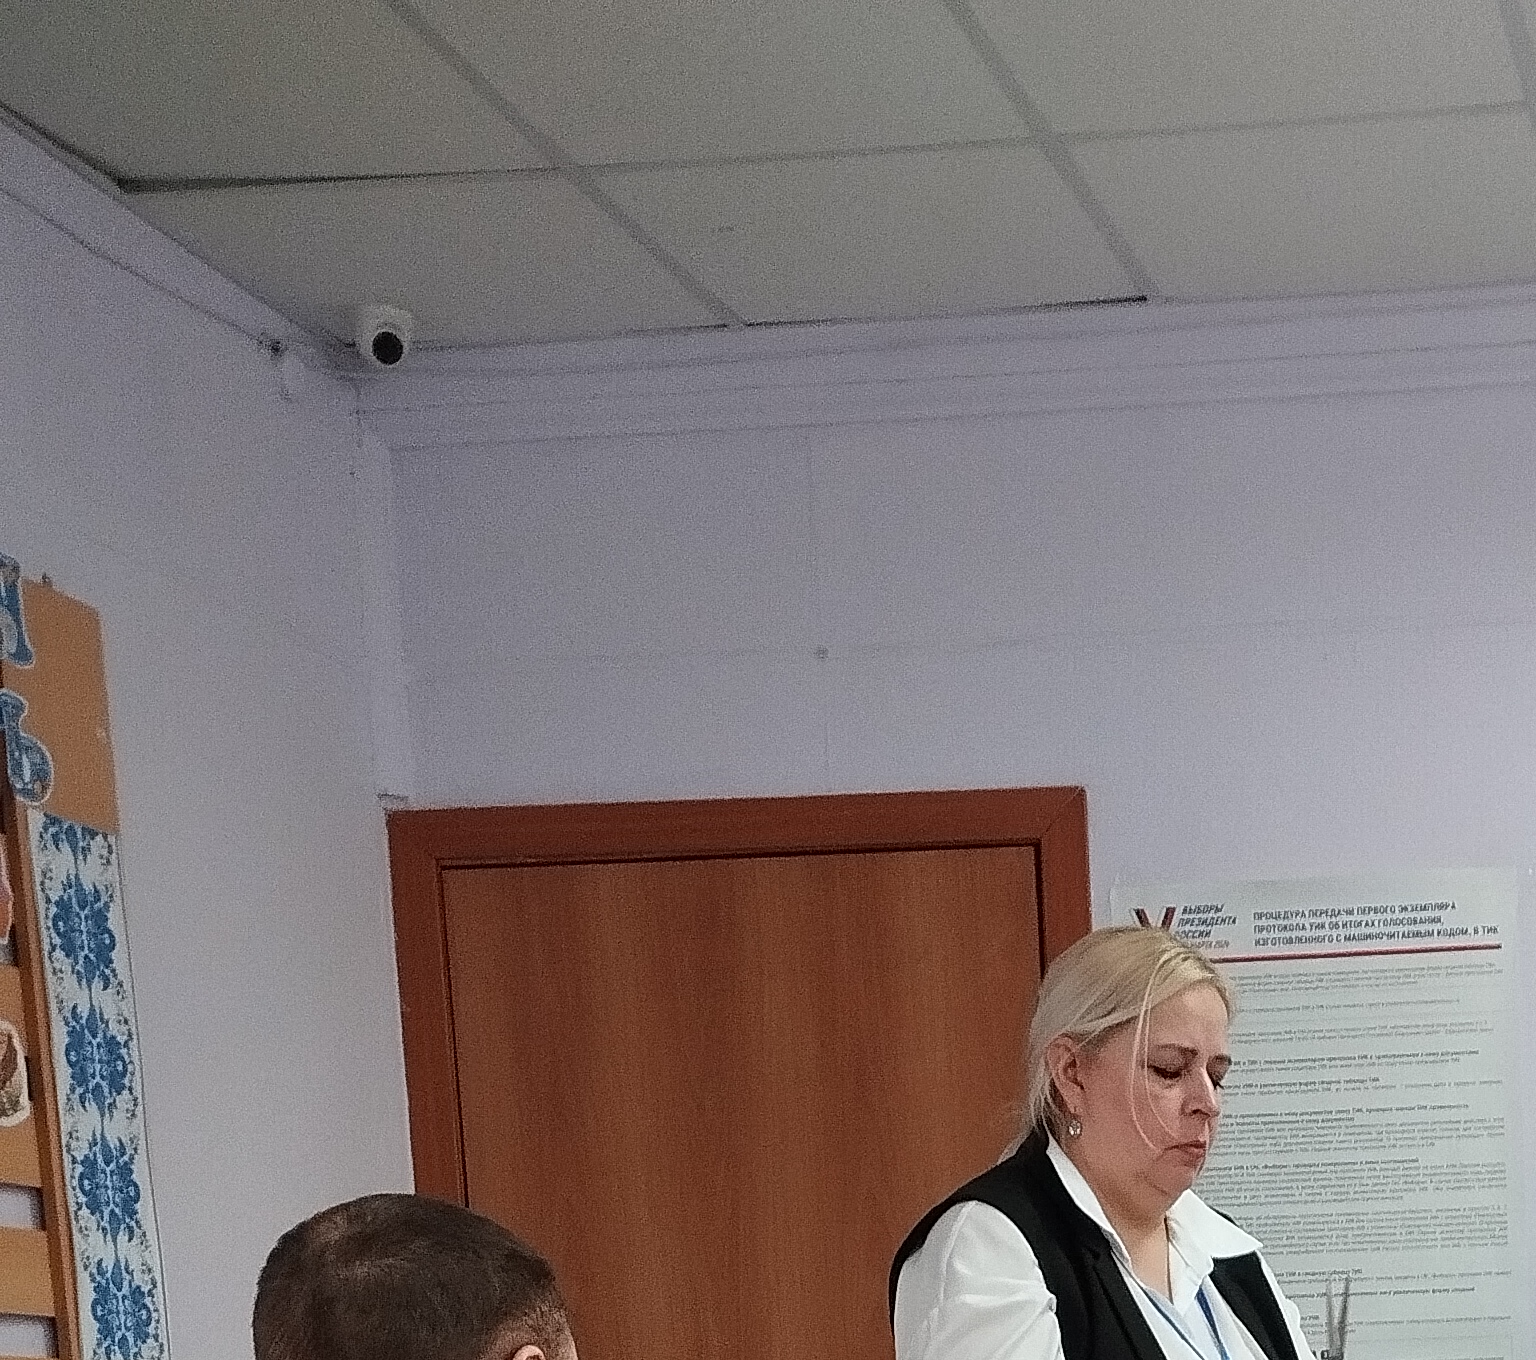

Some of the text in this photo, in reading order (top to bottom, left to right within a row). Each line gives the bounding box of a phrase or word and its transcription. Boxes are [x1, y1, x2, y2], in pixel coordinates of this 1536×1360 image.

[1181, 904, 1224, 916] ВЫБОРЫ
[1253, 909, 1306, 921] ПРОЦЕДУРА
[1308, 907, 1355, 919] ПЕРЕДАЧИ
[1357, 904, 1396, 916] ПЕРВОГО
[1177, 915, 1237, 928] ПРЕЗИДЕНТА
[1253, 921, 1307, 934] ПРОТОКОЛА
[1328, 920, 1340, 931] ОБ
[1336, 933, 1342, 943] С
[1473, 926, 1480, 935] В
[1481, 924, 1499, 935] ТИК
